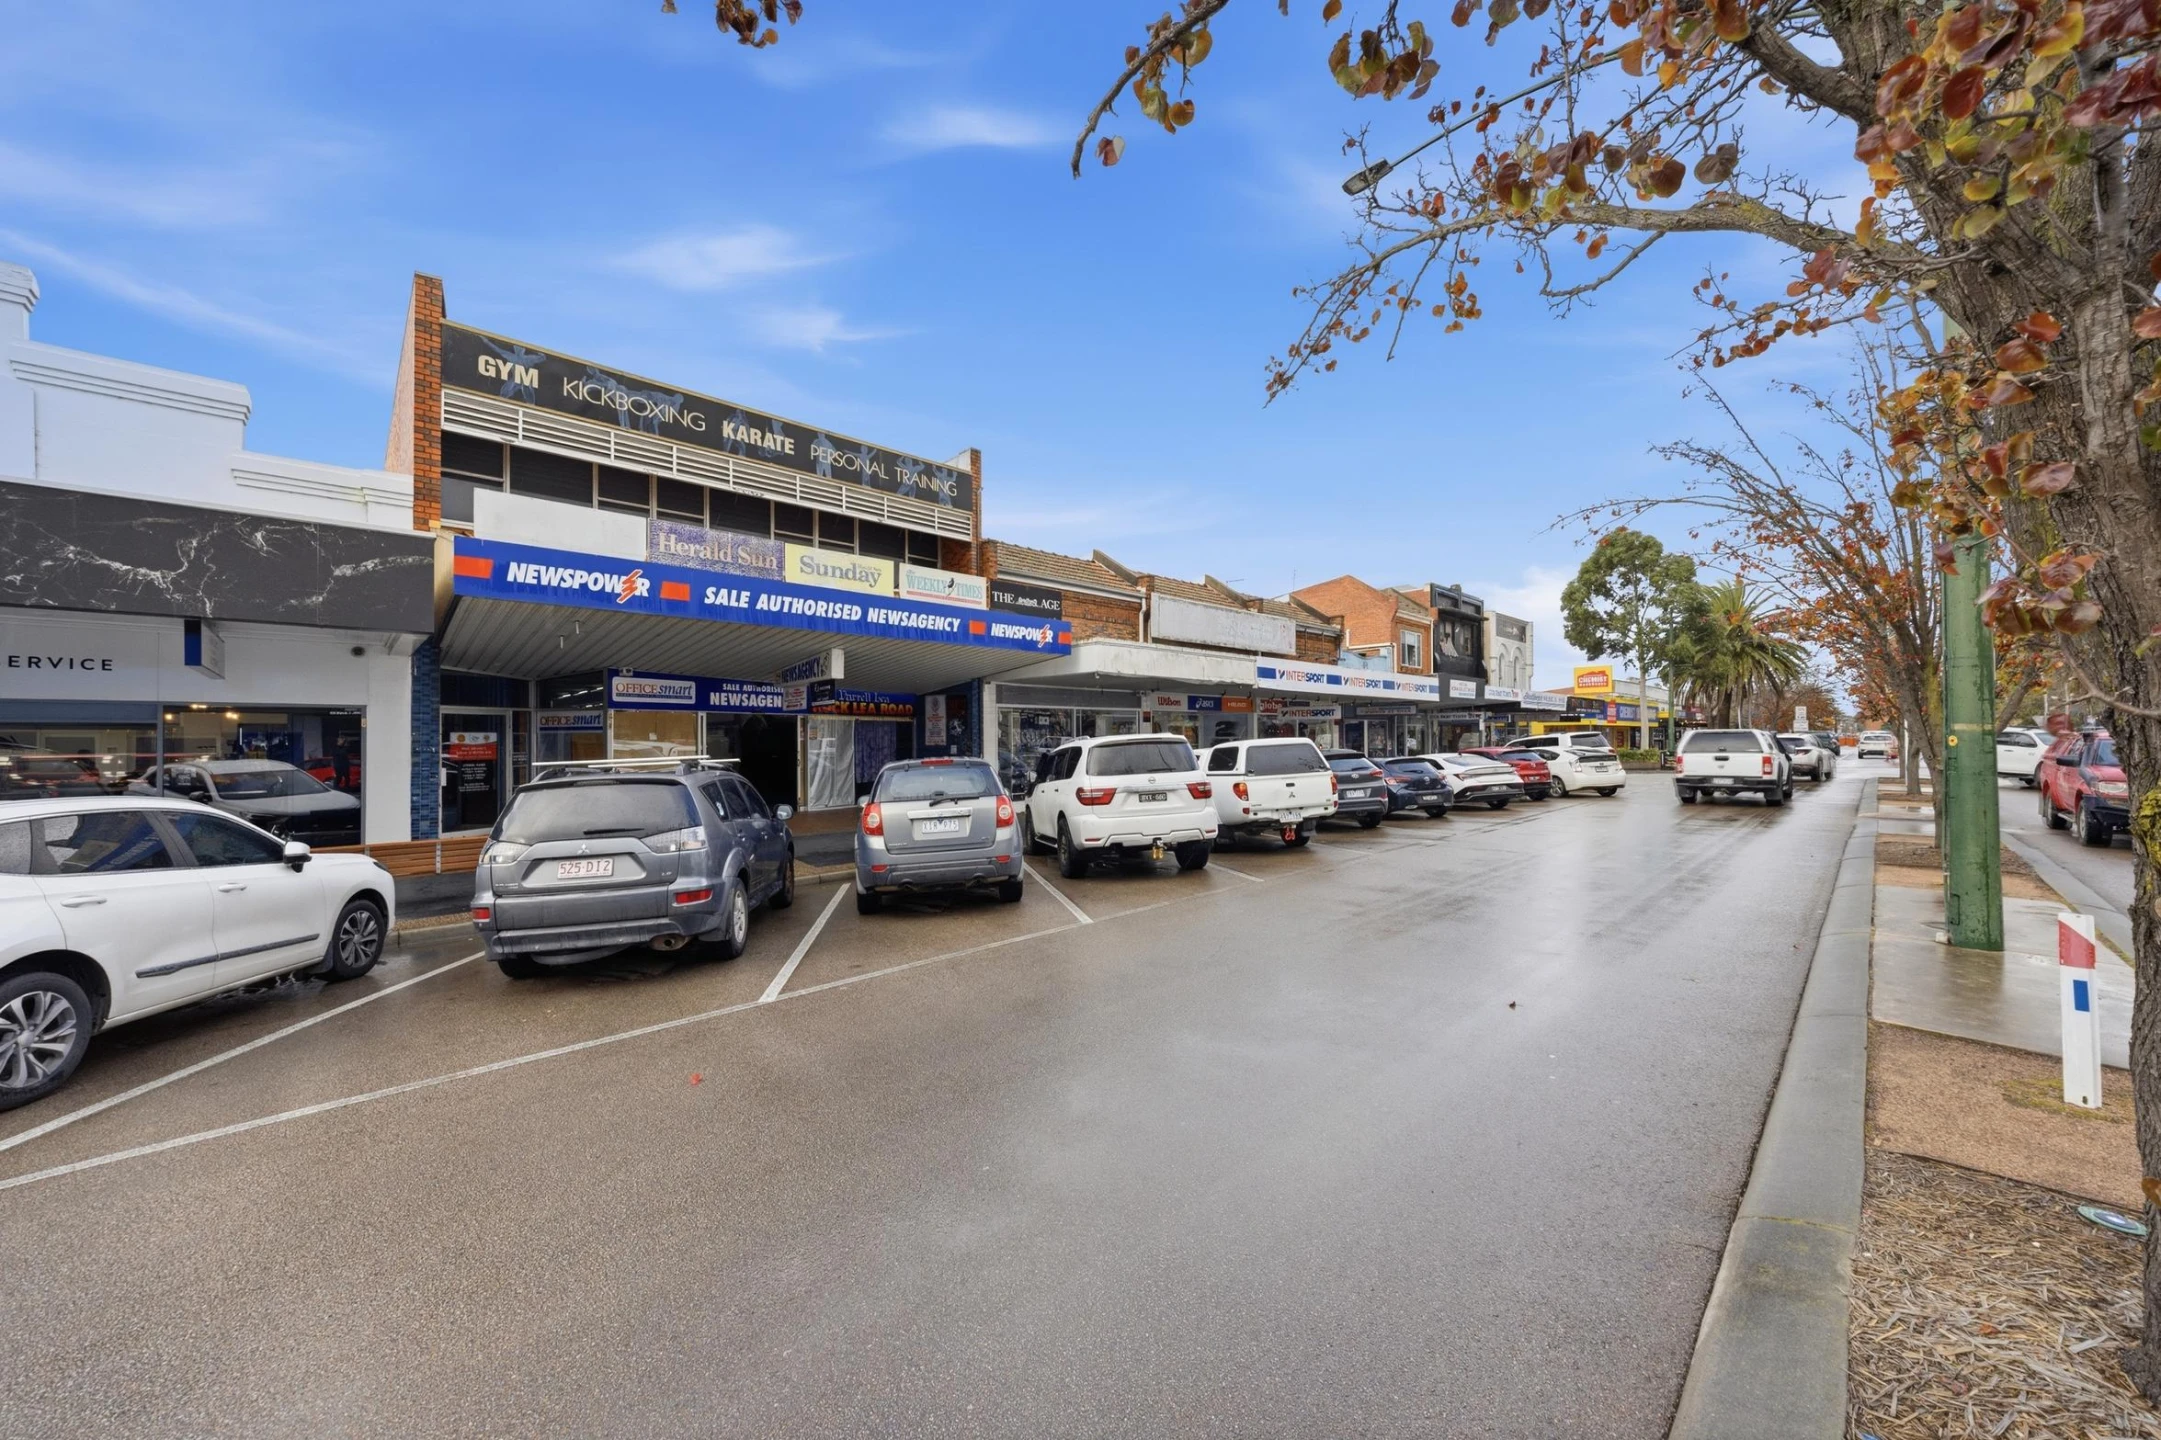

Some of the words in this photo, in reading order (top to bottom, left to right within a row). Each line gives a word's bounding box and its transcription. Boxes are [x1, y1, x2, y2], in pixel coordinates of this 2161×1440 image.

[477, 354, 539, 389] GYM
[563, 376, 706, 431] KICKBOXING
[722, 420, 795, 455] KARATE
[811, 444, 889, 480] PERSONAL
[894, 466, 957, 497] TRAINING
[659, 531, 734, 563] Herald
[738, 545, 778, 570] Sun
[799, 554, 882, 588] Sunday
[905, 574, 948, 594] WEEKLY
[955, 582, 983, 599] TIMES
[991, 590, 1015, 604] THE
[1040, 599, 1061, 610] AGE
[704, 586, 750, 608] SALE
[755, 593, 862, 621] AUTHORISED
[867, 607, 961, 632] NEWSAGENCY
[0, 655, 113, 671] ERVICE
[1286, 670, 1325, 684] INTERSPORT
[1349, 677, 1381, 689] INTERSPORT
[722, 683, 740, 691] SALE
[709, 692, 782, 708] NEWSAGEN
[852, 702, 876, 714] LEA
[880, 703, 913, 714] ROAD
[1157, 696, 1182, 707] Wilson
[1289, 708, 1336, 717] INTERSPORT
